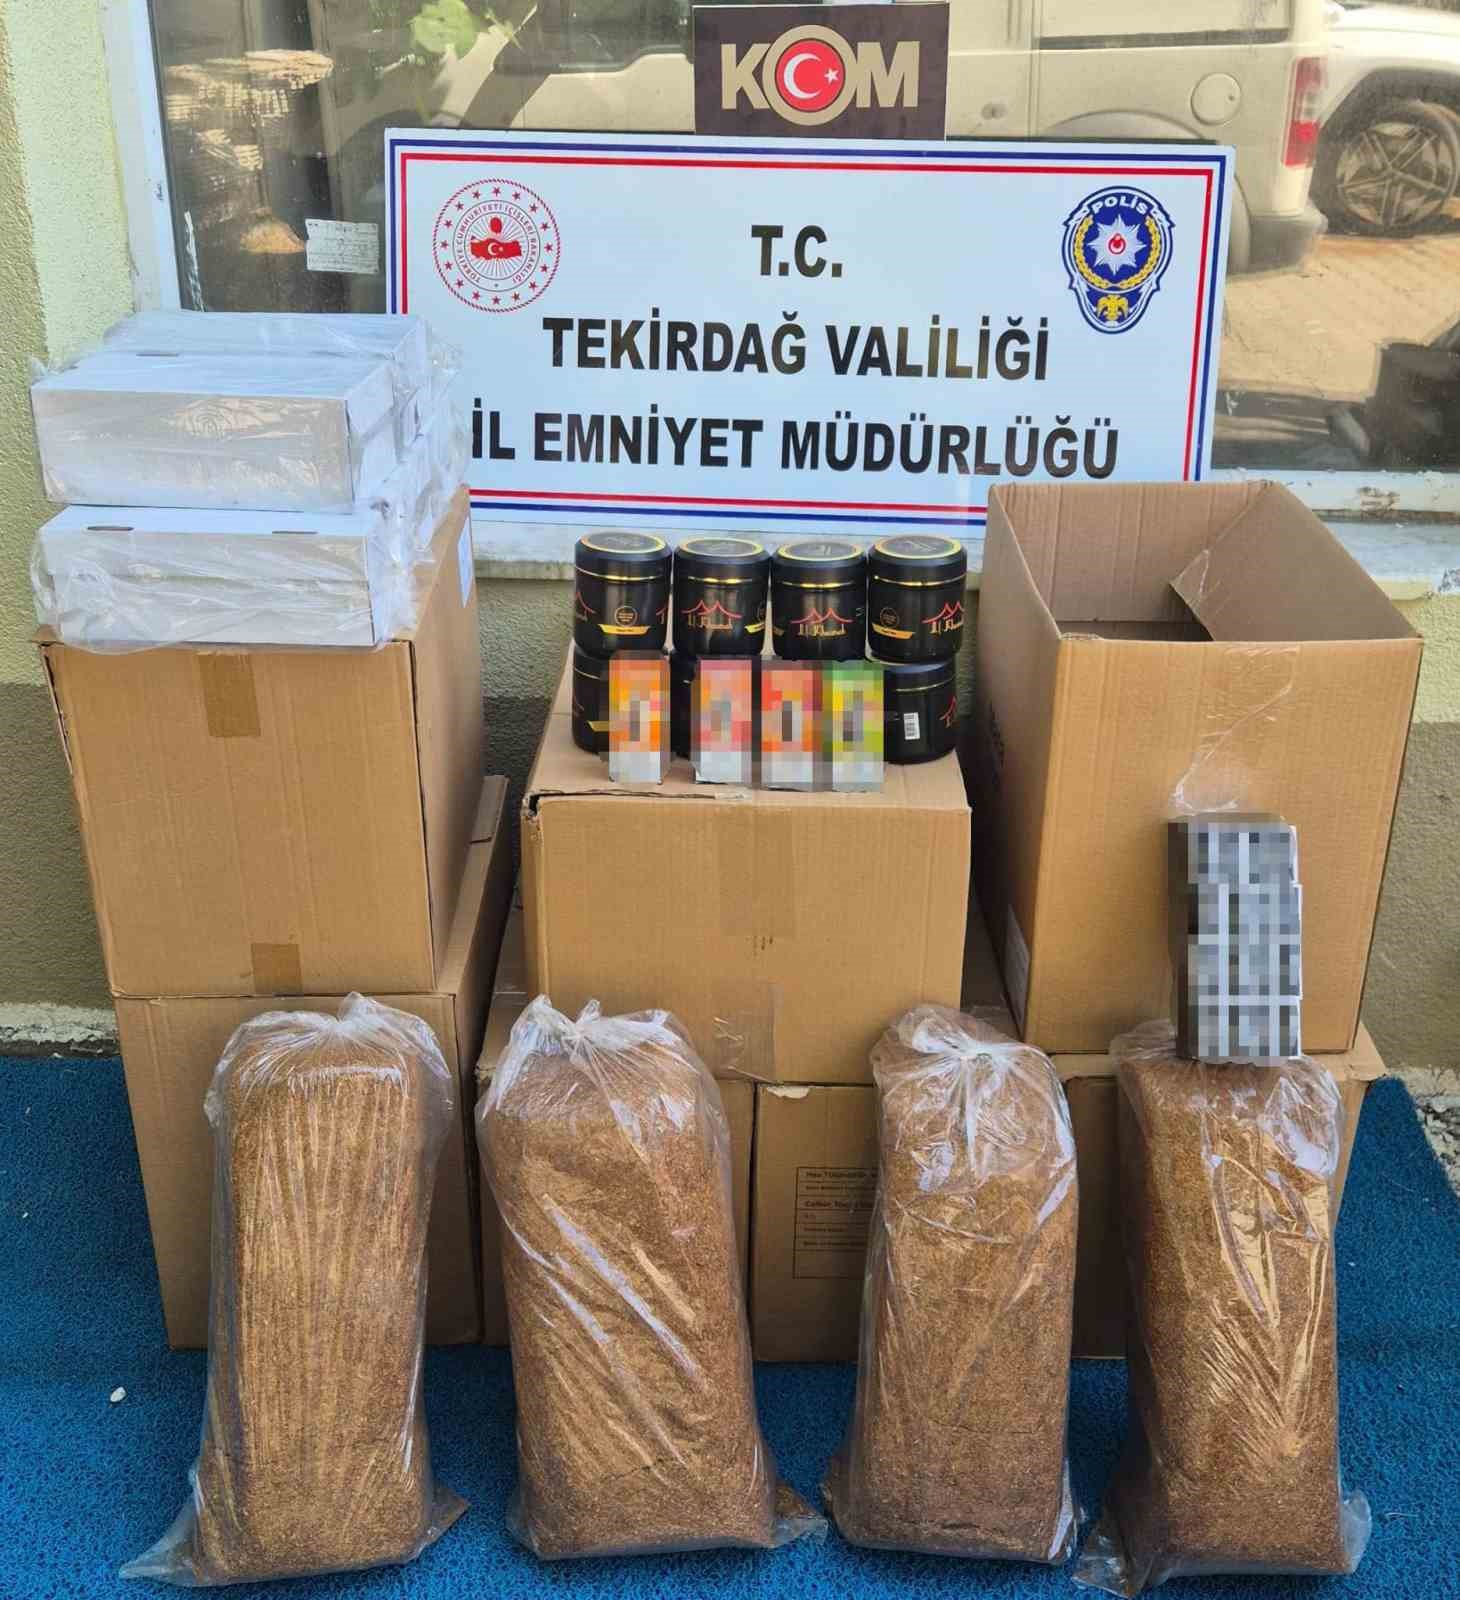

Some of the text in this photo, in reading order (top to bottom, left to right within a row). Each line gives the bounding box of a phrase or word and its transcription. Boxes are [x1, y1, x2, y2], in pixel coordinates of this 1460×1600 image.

[721, 24, 920, 126] KOM
[1091, 196, 1148, 215] POLİS
[751, 225, 843, 278] T.C.
[542, 307, 1049, 380] TEKİRDAĞ VALİLİĞİ
[472, 398, 1119, 479] İL EMNİYET MÜDÜRLÜĞÜ
